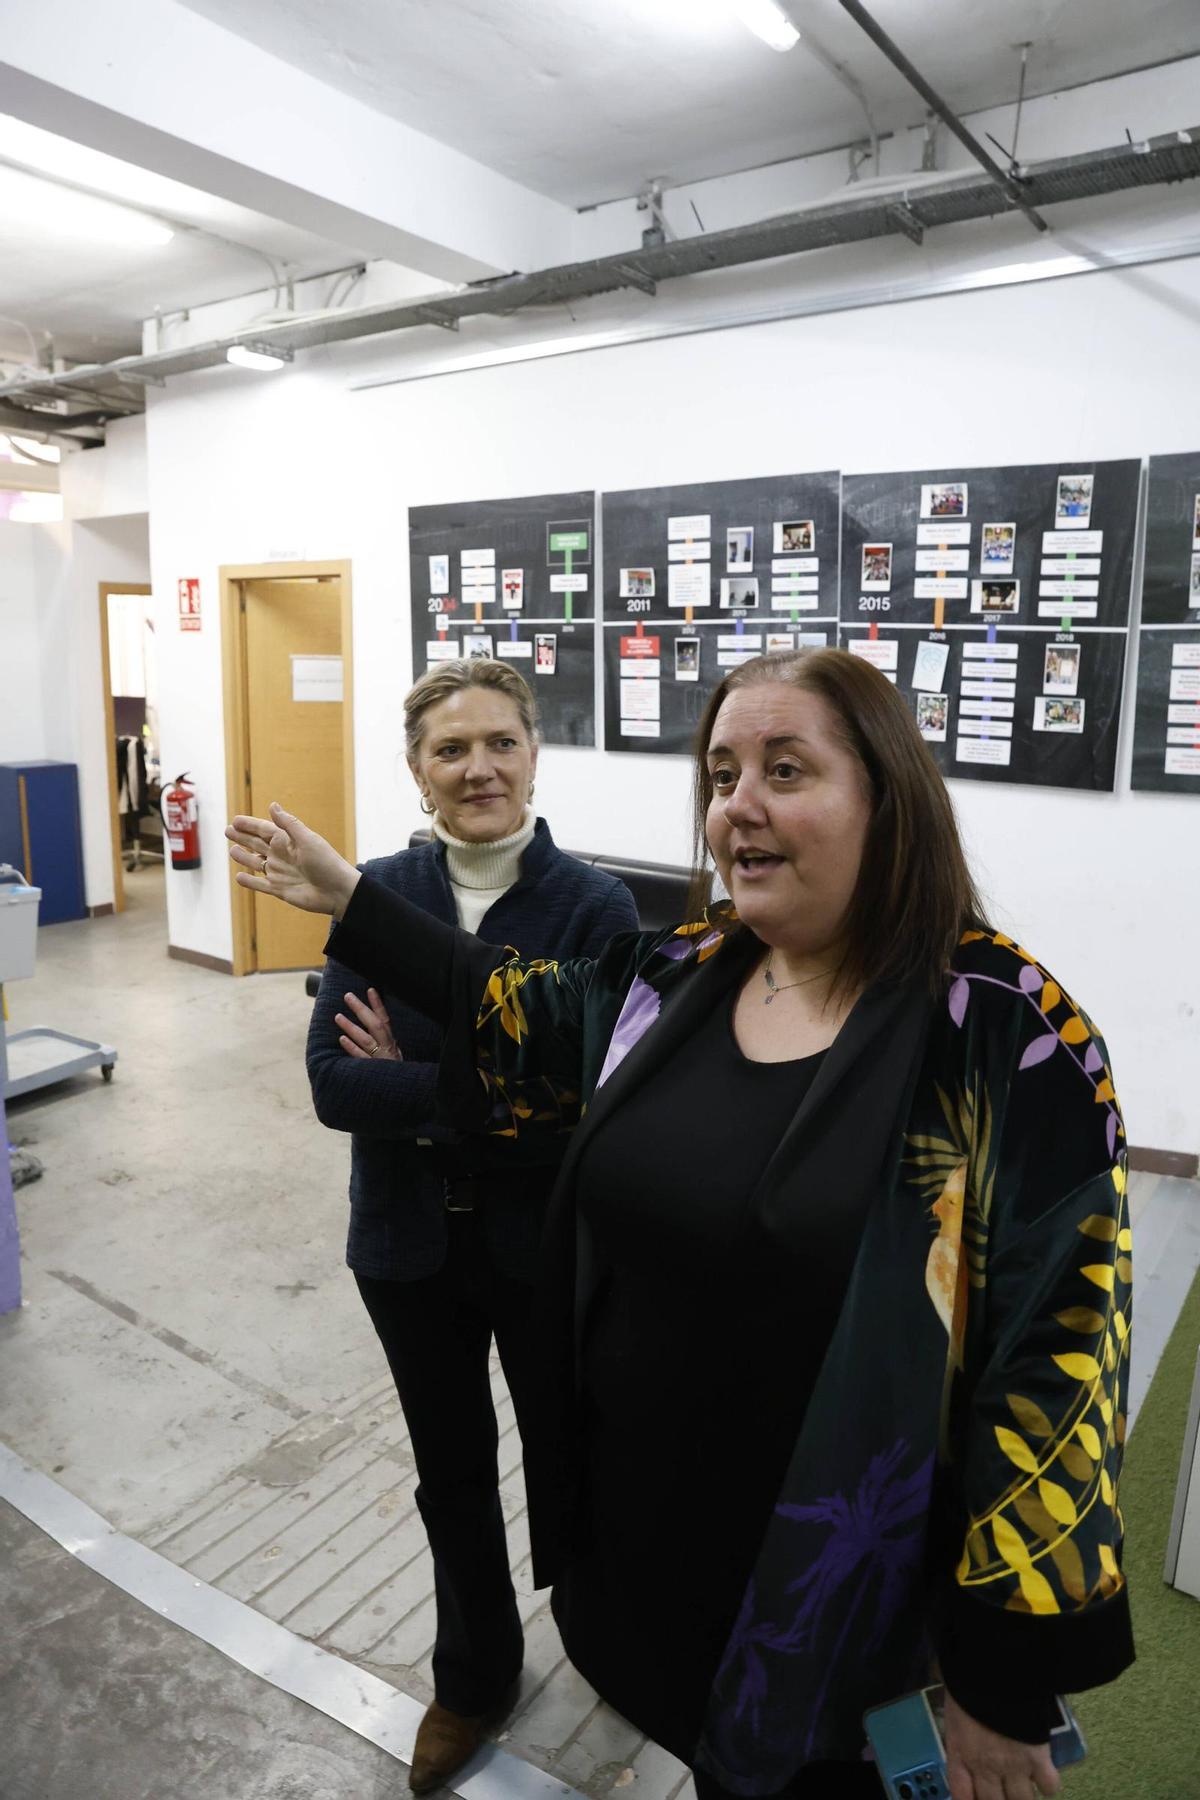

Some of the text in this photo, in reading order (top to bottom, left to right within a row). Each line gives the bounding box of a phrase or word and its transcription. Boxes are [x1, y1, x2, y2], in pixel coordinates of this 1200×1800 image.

[627, 599, 650, 612] 2011
[858, 597, 891, 611] 2015
[983, 615, 1001, 623] 2017
[928, 632, 946, 640] 2016
[1055, 633, 1074, 642] 2018
